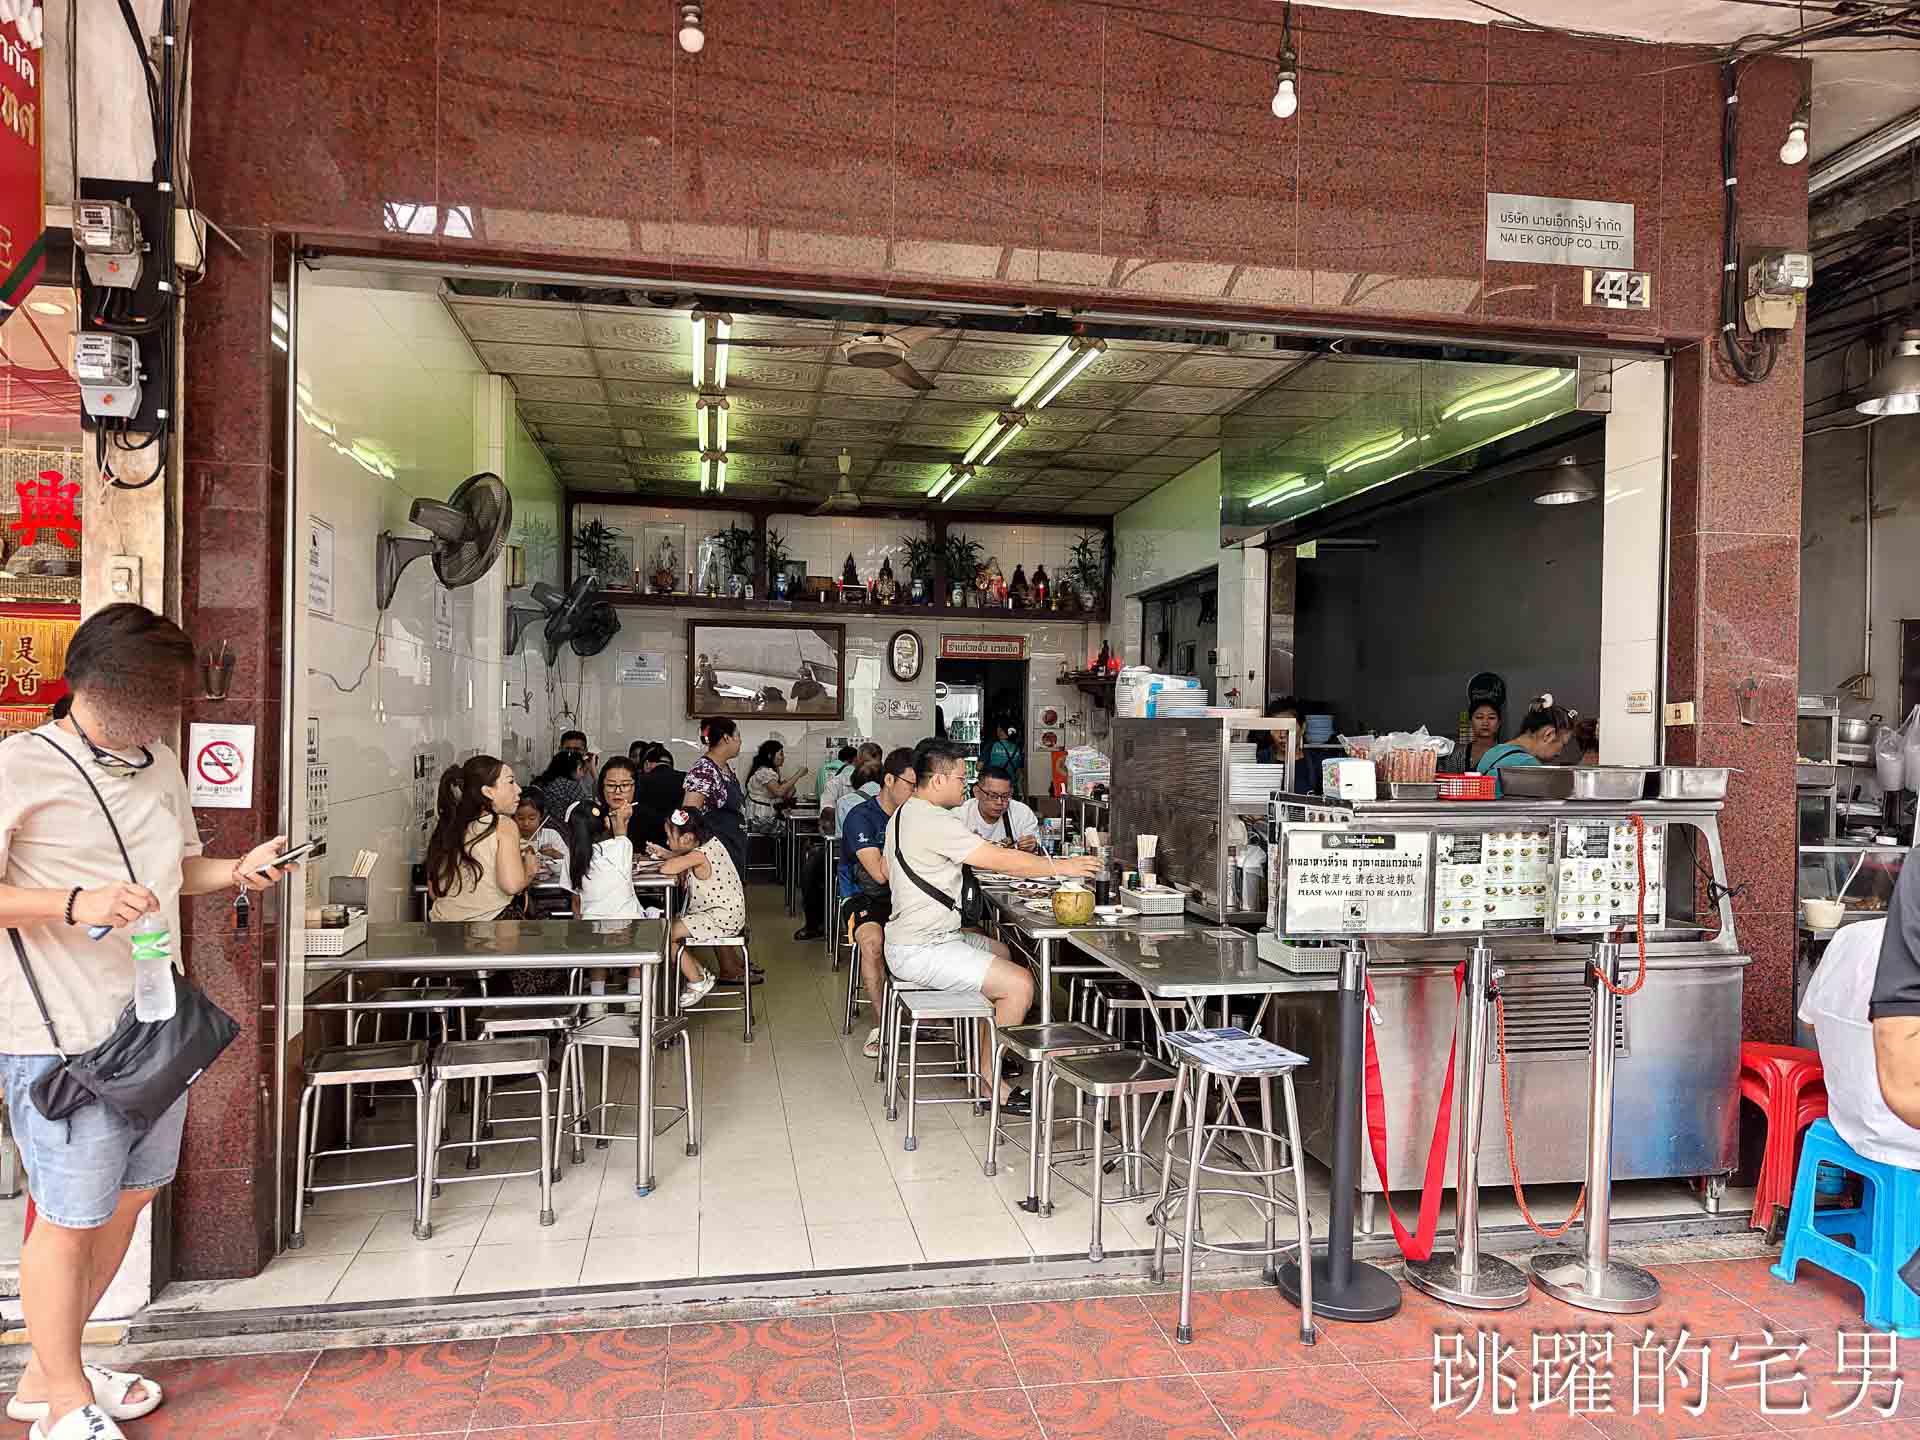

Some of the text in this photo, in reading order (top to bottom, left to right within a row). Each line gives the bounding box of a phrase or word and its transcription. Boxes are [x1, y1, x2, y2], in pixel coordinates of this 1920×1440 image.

[1500, 211, 1529, 225] บริษัท
[1594, 217, 1622, 232] จำกัด
[1500, 233, 1517, 243] NAI
[1520, 234, 1534, 244] EK
[1536, 236, 1575, 247] GROUP
[1595, 272, 1645, 303] 442
[9, 470, 82, 549] 興
[1299, 872, 1352, 885] 在饭馆里吃
[1298, 889, 1322, 897] PLEASE
[1365, 889, 1375, 897] TO
